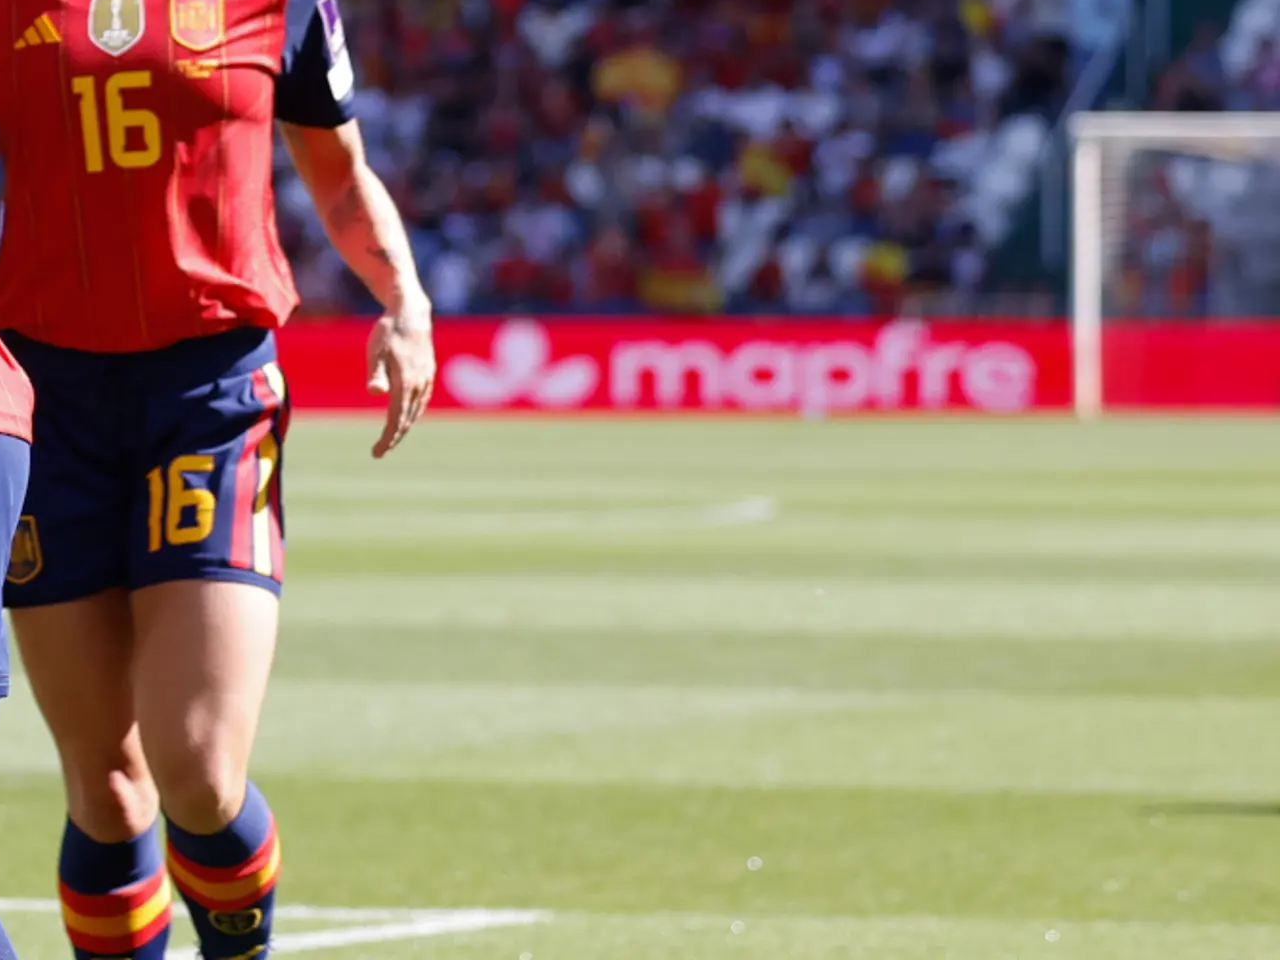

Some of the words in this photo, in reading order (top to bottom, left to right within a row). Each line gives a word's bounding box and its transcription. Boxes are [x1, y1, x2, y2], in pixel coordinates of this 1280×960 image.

[71, 70, 162, 173] 16
[609, 319, 1038, 421] mapfre
[146, 453, 216, 553] 16
